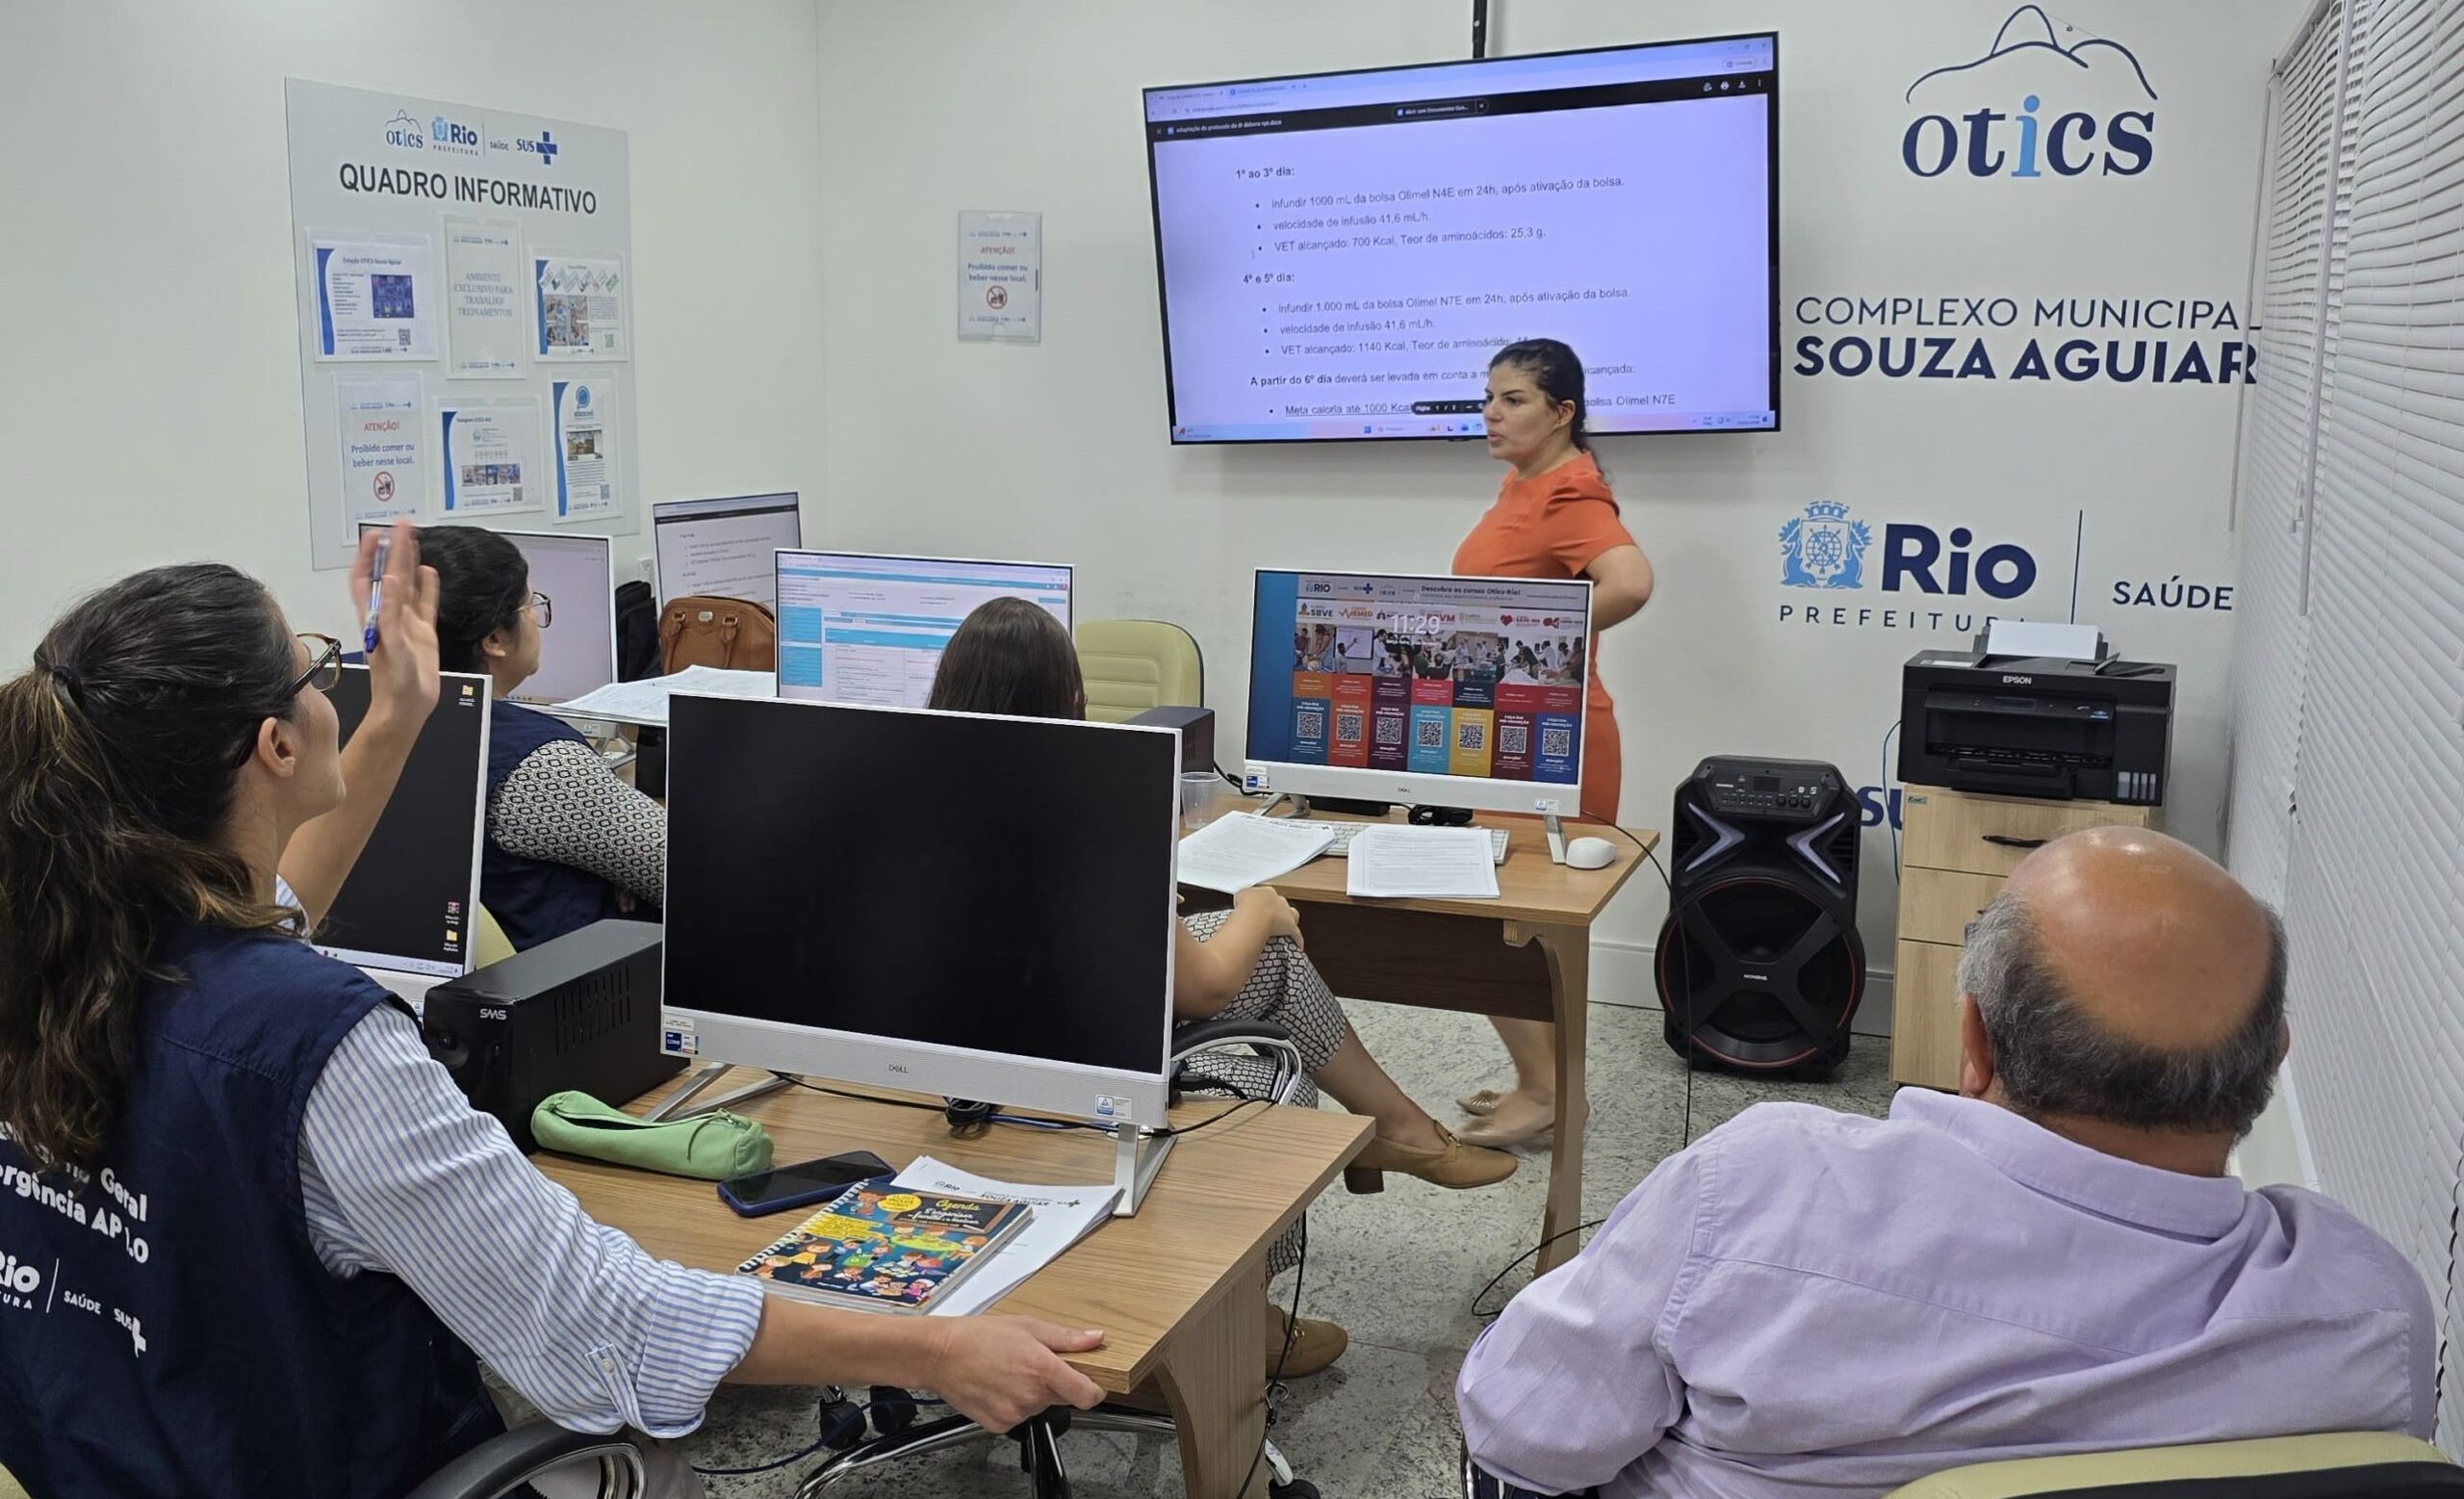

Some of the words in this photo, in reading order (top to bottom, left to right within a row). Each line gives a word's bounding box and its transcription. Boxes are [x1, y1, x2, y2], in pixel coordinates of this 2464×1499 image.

[386, 128, 423, 148] otics
[450, 123, 478, 145] Rio
[1901, 94, 2155, 177] otics
[516, 138, 535, 153] SUS
[1248, 170, 1261, 179] ao
[1276, 167, 1296, 178] dia:
[340, 163, 447, 199] QUADRO
[454, 175, 597, 215] INFORMATIVO
[1271, 196, 1307, 209] infundir
[1310, 195, 1334, 207] 1000
[1336, 195, 1352, 205] mL
[1354, 193, 1367, 204] da
[1369, 191, 1396, 202] bolsa
[1432, 187, 1454, 199] N4E
[1457, 188, 1473, 197] em
[1476, 185, 1499, 196] 24h,
[1502, 183, 1527, 195] após
[1530, 179, 1574, 193] ativação
[1577, 178, 1589, 189] da
[1593, 176, 1625, 188] bolsa.
[1273, 219, 1323, 231] velocidade
[1326, 216, 1339, 227] de
[1342, 215, 1376, 226] infusão
[1274, 241, 1295, 252] VET
[1297, 238, 1348, 251] alcançado:
[1351, 237, 1371, 247] 700
[1401, 234, 1424, 245] Teor
[1425, 232, 1438, 244] de
[1441, 229, 1508, 244] aminoácidos:
[465, 271, 501, 283] AMBIENTE
[1276, 272, 1295, 283] dia:
[1278, 303, 1313, 314] infundir
[1345, 300, 1360, 311] mL
[1362, 299, 1374, 309] da
[1377, 297, 1403, 308] bolsa
[1440, 296, 1462, 306] N7E
[1465, 296, 1481, 305] em
[1509, 292, 1534, 305] após
[1537, 289, 1580, 303] ativação
[1583, 289, 1597, 299] da
[1600, 288, 1630, 298] bolsa.
[1795, 296, 2018, 327] COMPLEXO
[1280, 323, 1330, 335] velocidade
[1332, 321, 1345, 332] de
[1348, 320, 1381, 331] infusão
[1281, 345, 1301, 355] VET
[1358, 342, 1382, 352] 1140
[1412, 340, 1434, 350] Teor
[1437, 338, 1450, 349] de
[1793, 335, 1997, 379] SOUZA
[2010, 338, 2258, 384] AGUIAR
[1250, 376, 1258, 386] A
[1260, 375, 1287, 387] partir
[1290, 375, 1301, 385] do
[1317, 374, 1332, 384] dia
[1335, 372, 1367, 384] deverá
[1370, 374, 1385, 383] ser
[1388, 371, 1420, 382] levada
[1424, 373, 1438, 381] em
[1441, 370, 1468, 380] conta
[1286, 404, 1308, 415] Meta
[1346, 402, 1360, 414] até
[1364, 402, 1388, 413] 1000
[1616, 395, 1649, 406] Olimel
[1653, 394, 1675, 405] N7E
[364, 420, 400, 432] ATENÇÃO!
[351, 444, 381, 454] Proibido
[382, 443, 404, 452] comer
[352, 457, 374, 468] beber
[375, 457, 395, 466] nesse
[1881, 523, 2038, 600] Rio
[2112, 575, 2235, 611] SAÚDE
[1392, 614, 1441, 634] 11:29
[1779, 605, 2026, 633] PREFEITU
[2002, 675, 2032, 685] EPSON
[479, 1008, 507, 1021] SMS
[888, 1063, 909, 1073] DELL
[100, 1167, 147, 1222] Geral
[936, 1199, 981, 1211] Agenda
[63, 1290, 102, 1315] SAÚDE
